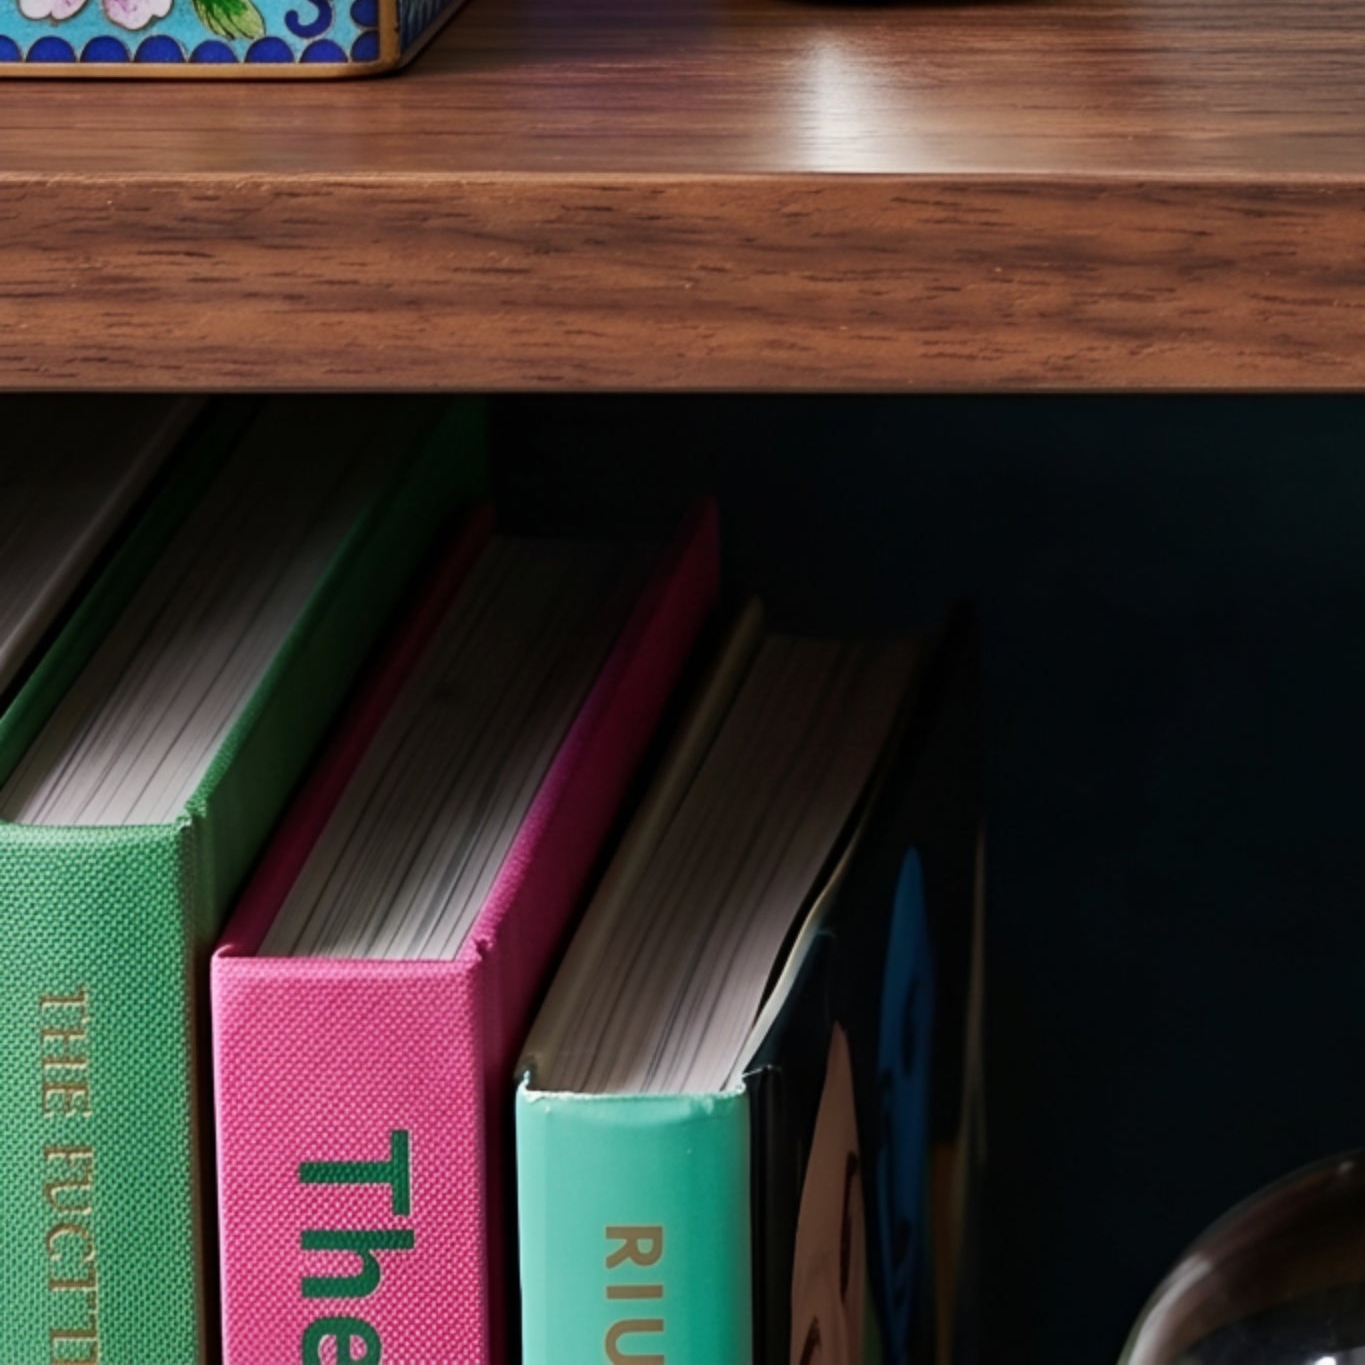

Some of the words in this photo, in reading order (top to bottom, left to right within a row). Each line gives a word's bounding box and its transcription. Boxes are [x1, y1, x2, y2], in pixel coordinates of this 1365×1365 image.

[40, 984, 92, 1117] THE
[299, 1129, 415, 1365] The
[604, 1226, 665, 1365] RIU
